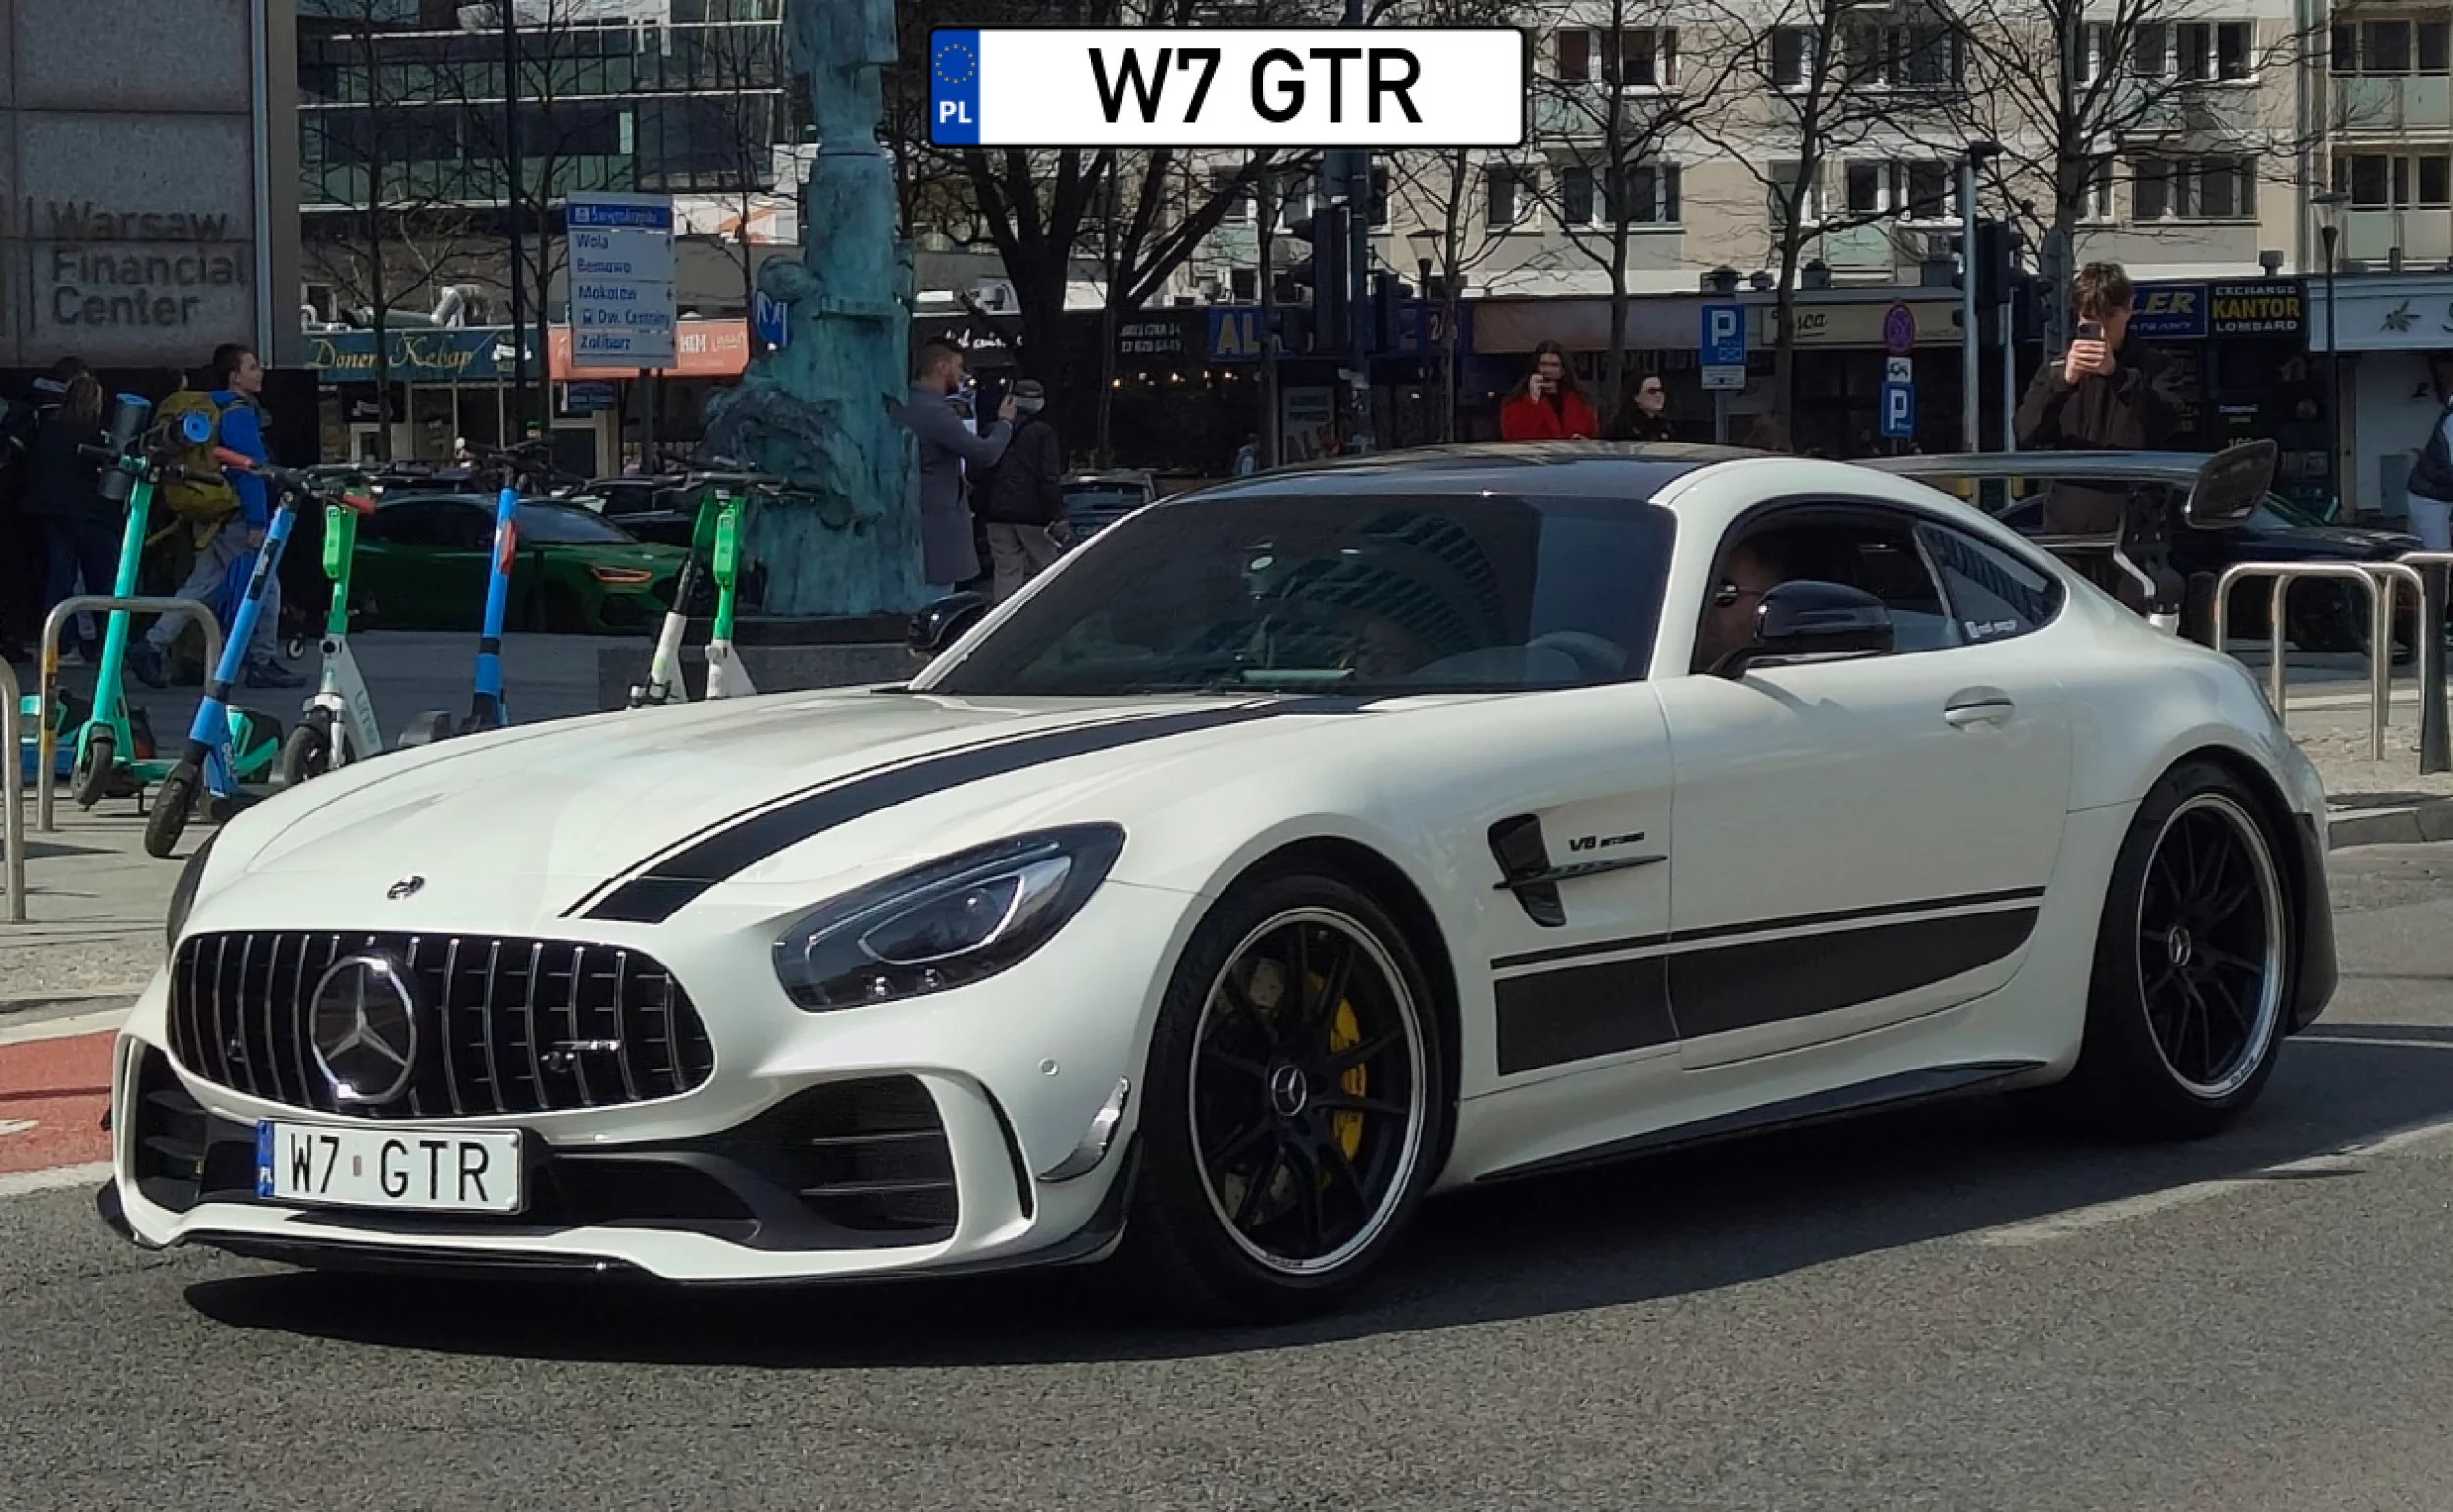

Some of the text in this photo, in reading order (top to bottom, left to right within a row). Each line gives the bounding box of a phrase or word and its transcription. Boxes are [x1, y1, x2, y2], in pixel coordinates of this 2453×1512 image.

[49, 201, 229, 240] Warsaw
[52, 247, 250, 287] Financial
[52, 285, 202, 326] Center
[2211, 296, 2301, 320] KANTOR
[2215, 285, 2297, 296] EXCHANGE
[2215, 319, 2298, 332] LOMBARD
[290, 1132, 490, 1202] W7 GTR
